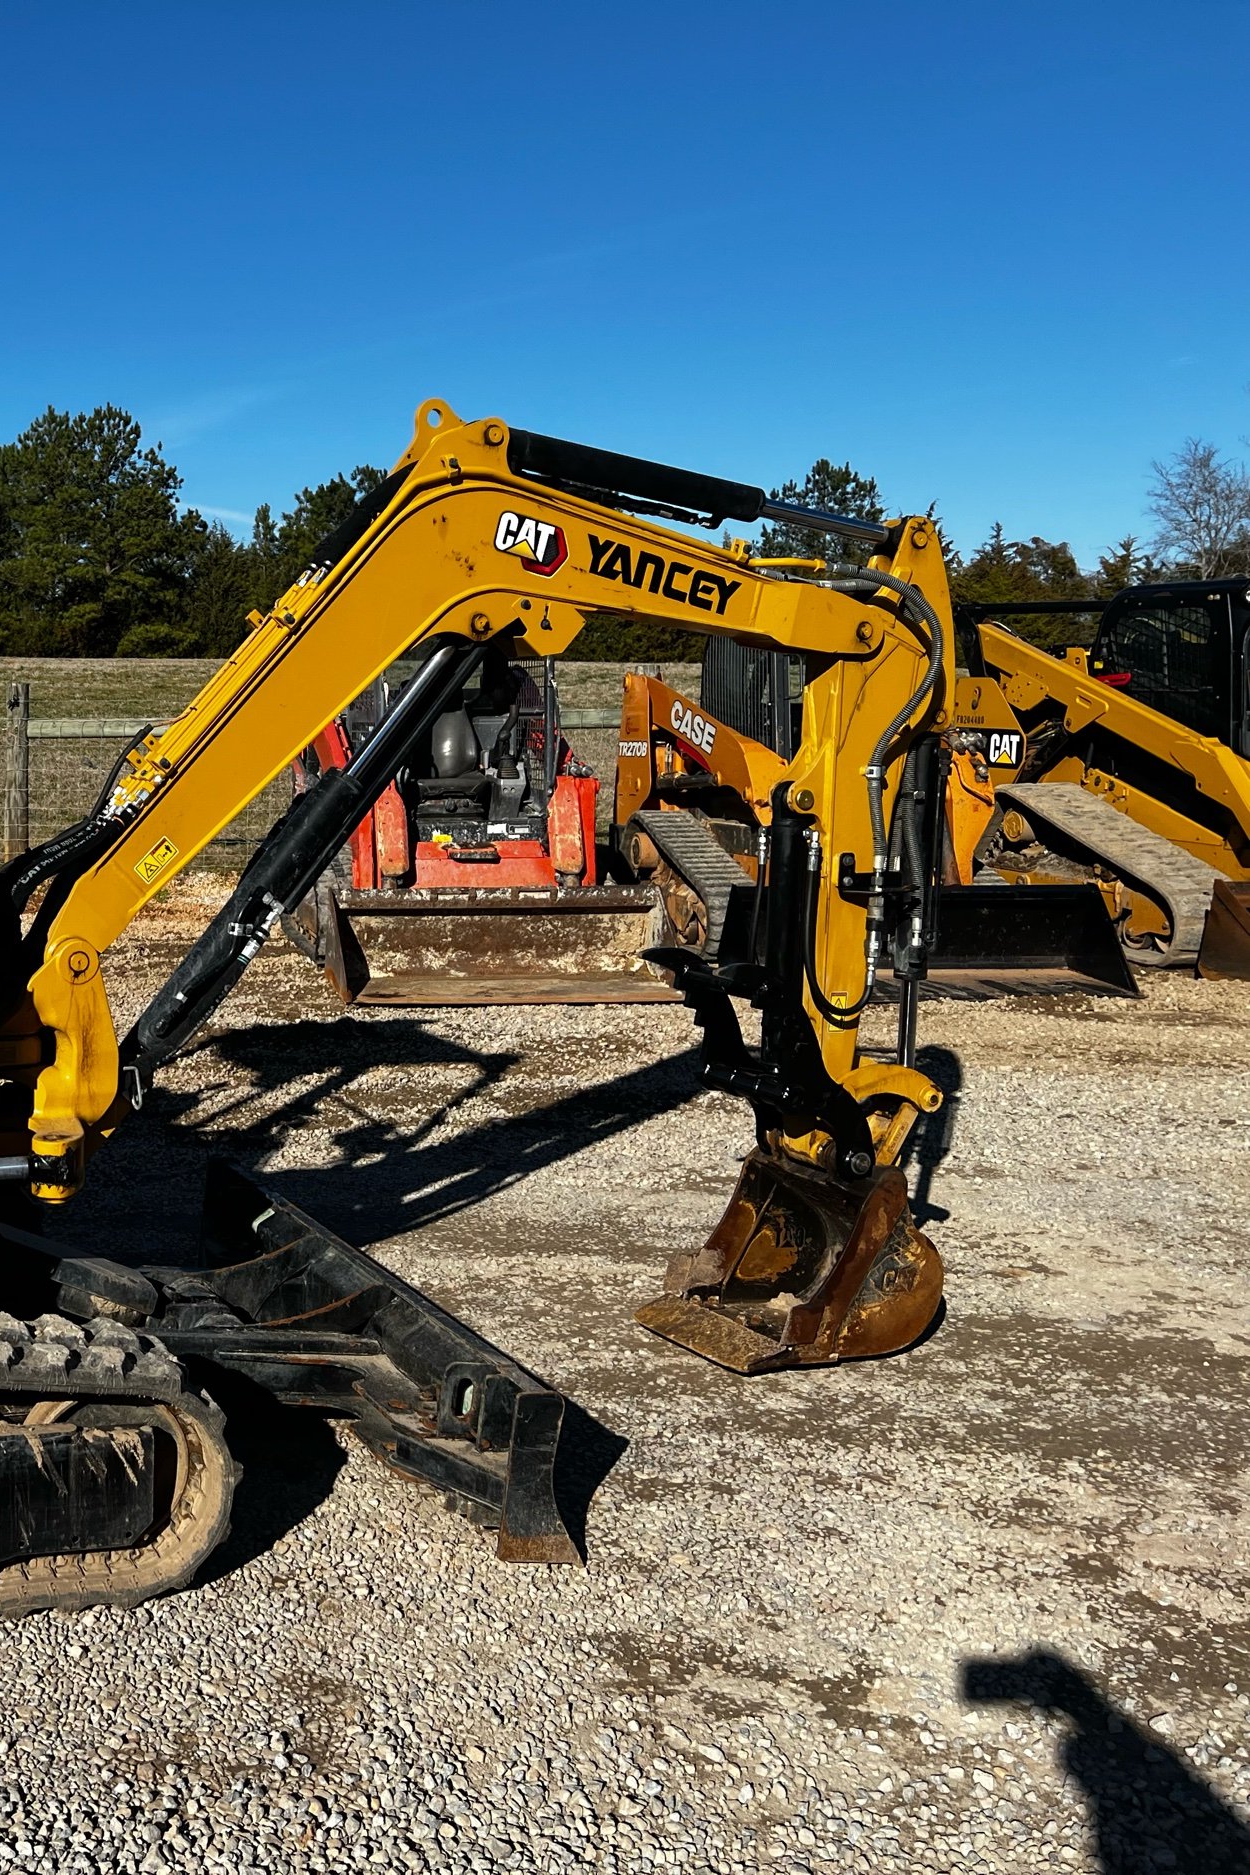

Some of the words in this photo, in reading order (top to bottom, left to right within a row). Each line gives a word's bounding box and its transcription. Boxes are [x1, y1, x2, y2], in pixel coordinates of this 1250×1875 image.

[495, 511, 556, 563] CAT
[588, 533, 742, 616] YANCEY
[618, 741, 648, 757] TR270B
[670, 700, 717, 755] CASE
[989, 733, 1021, 765] CAT
